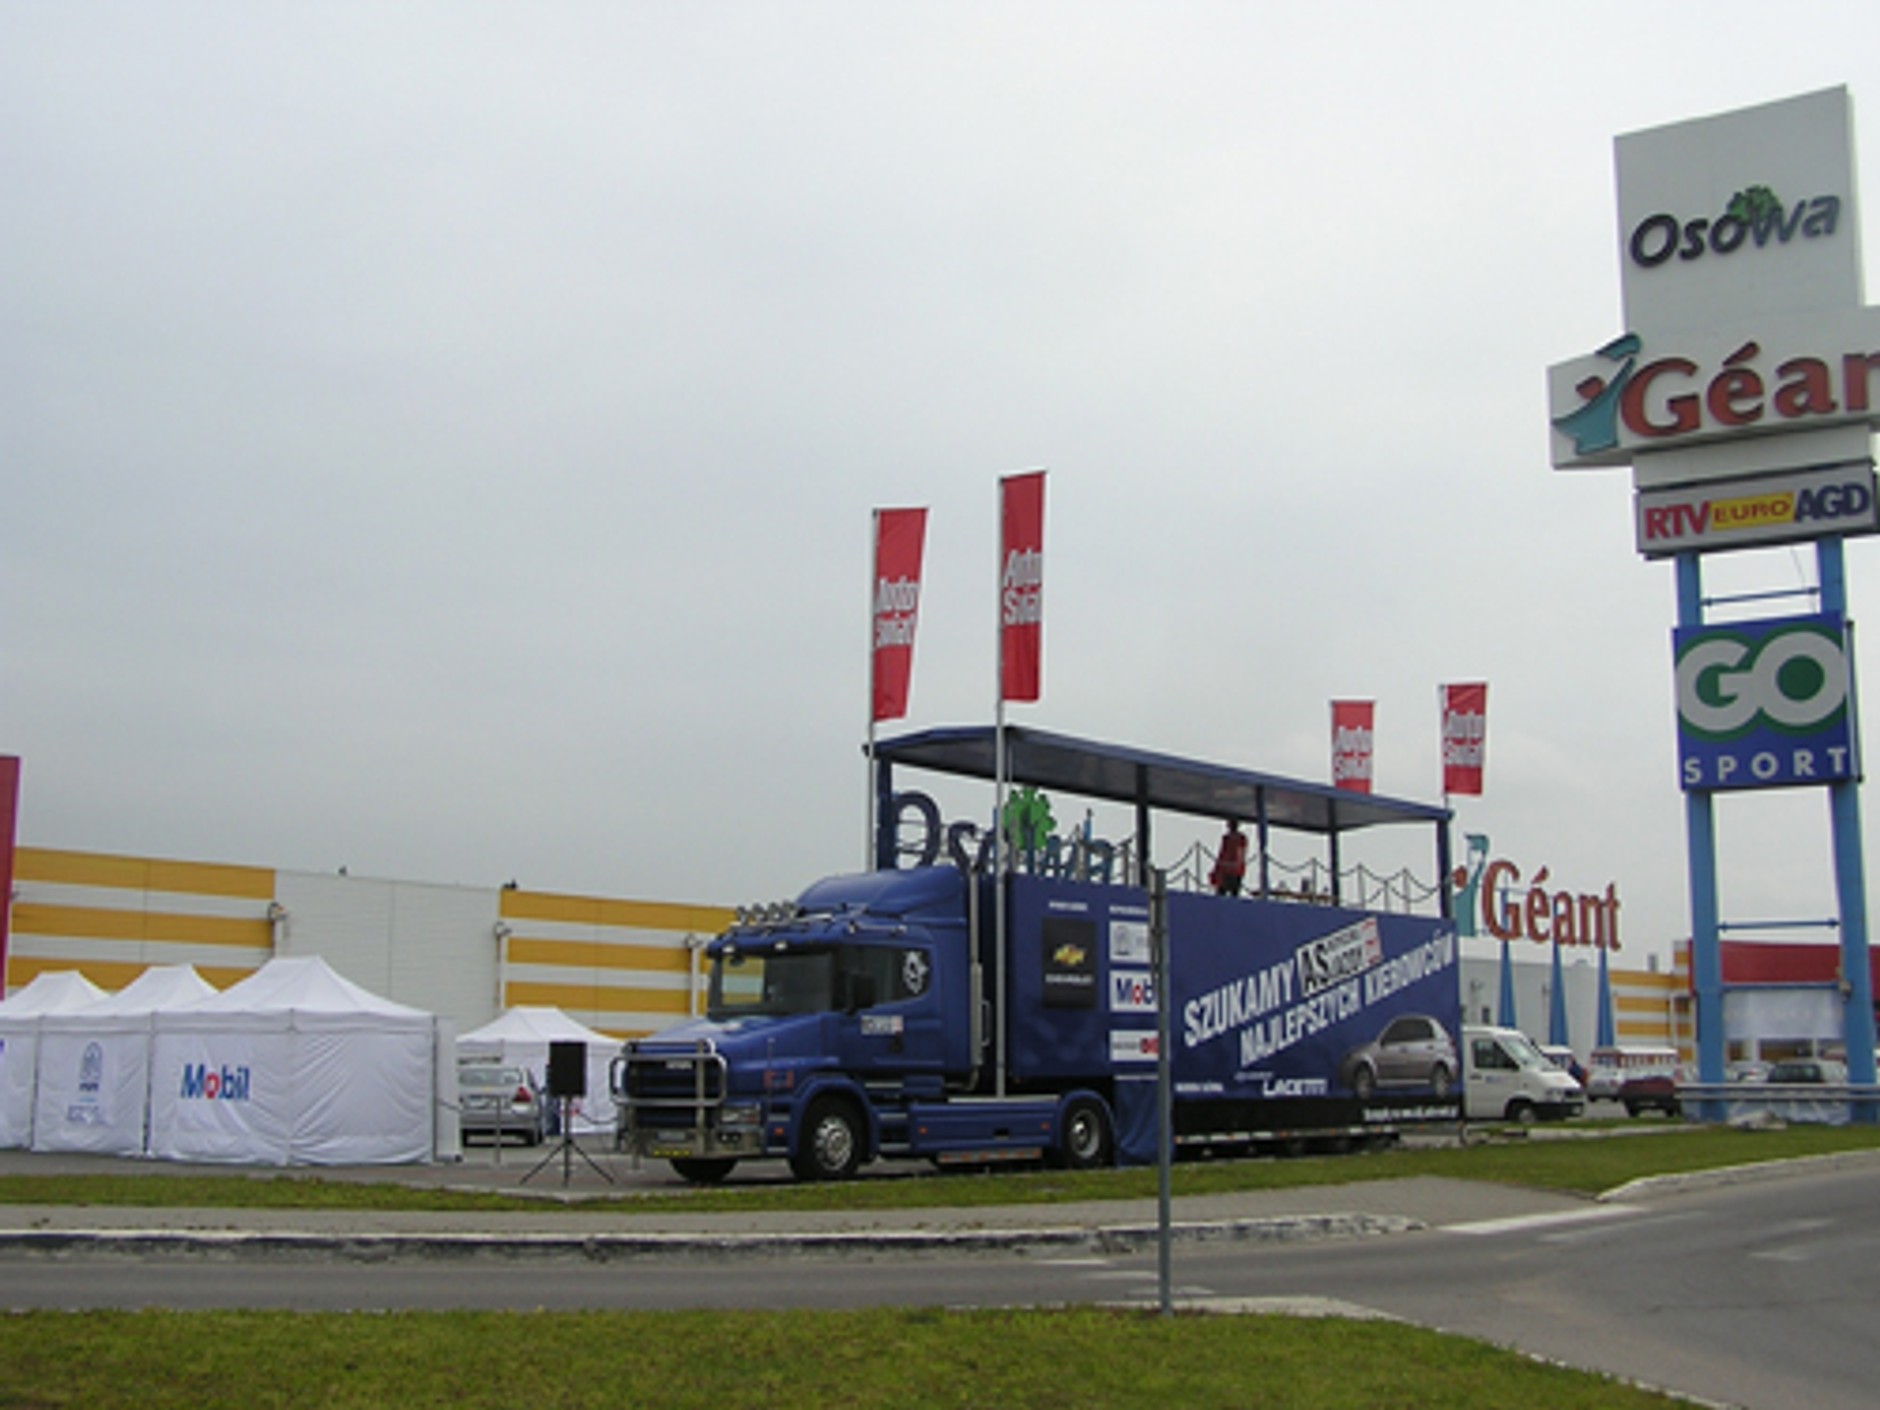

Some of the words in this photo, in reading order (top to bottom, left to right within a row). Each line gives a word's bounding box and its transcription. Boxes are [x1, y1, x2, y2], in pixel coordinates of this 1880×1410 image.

[1629, 195, 1840, 268] Osowa
[1644, 501, 1711, 540] RTV
[1713, 500, 1790, 524] EURO
[1795, 483, 1870, 523] AGD
[1677, 631, 1847, 732] GO
[1684, 747, 1847, 784] SPORT
[1481, 858, 1621, 952] Géant
[1184, 958, 1294, 1047] SZUKAMY
[180, 1063, 250, 1100] Mobil
